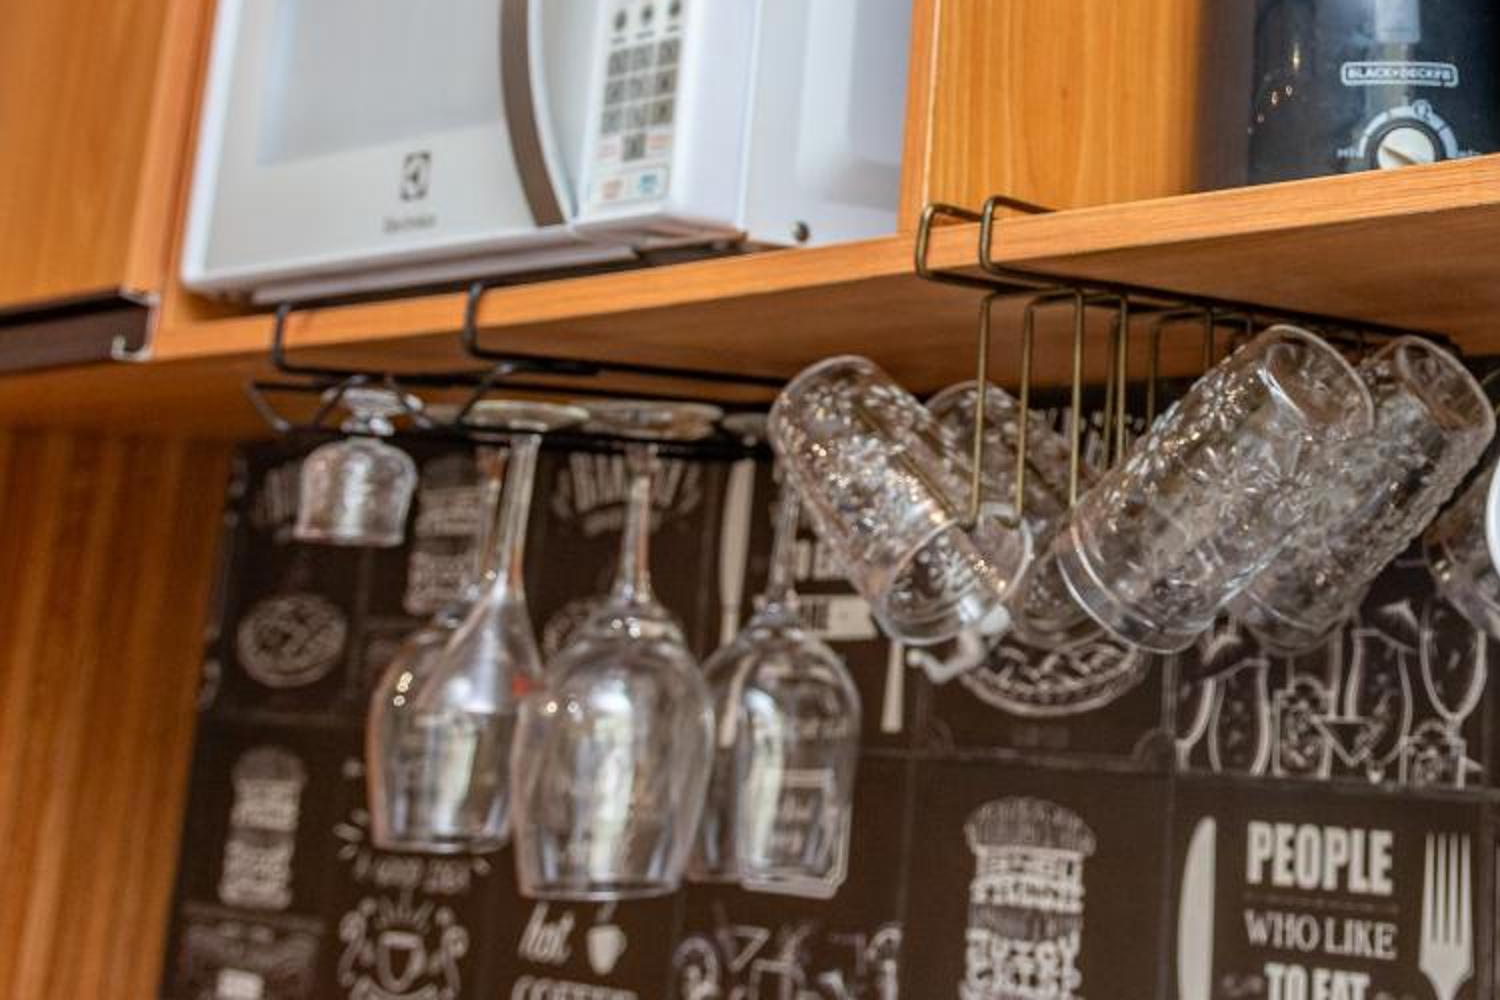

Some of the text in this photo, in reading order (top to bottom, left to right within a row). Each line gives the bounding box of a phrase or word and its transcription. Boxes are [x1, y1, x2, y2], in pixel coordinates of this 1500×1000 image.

[1246, 820, 1394, 896] PEOPLE
[1244, 908, 1398, 961] WHO LIKE
